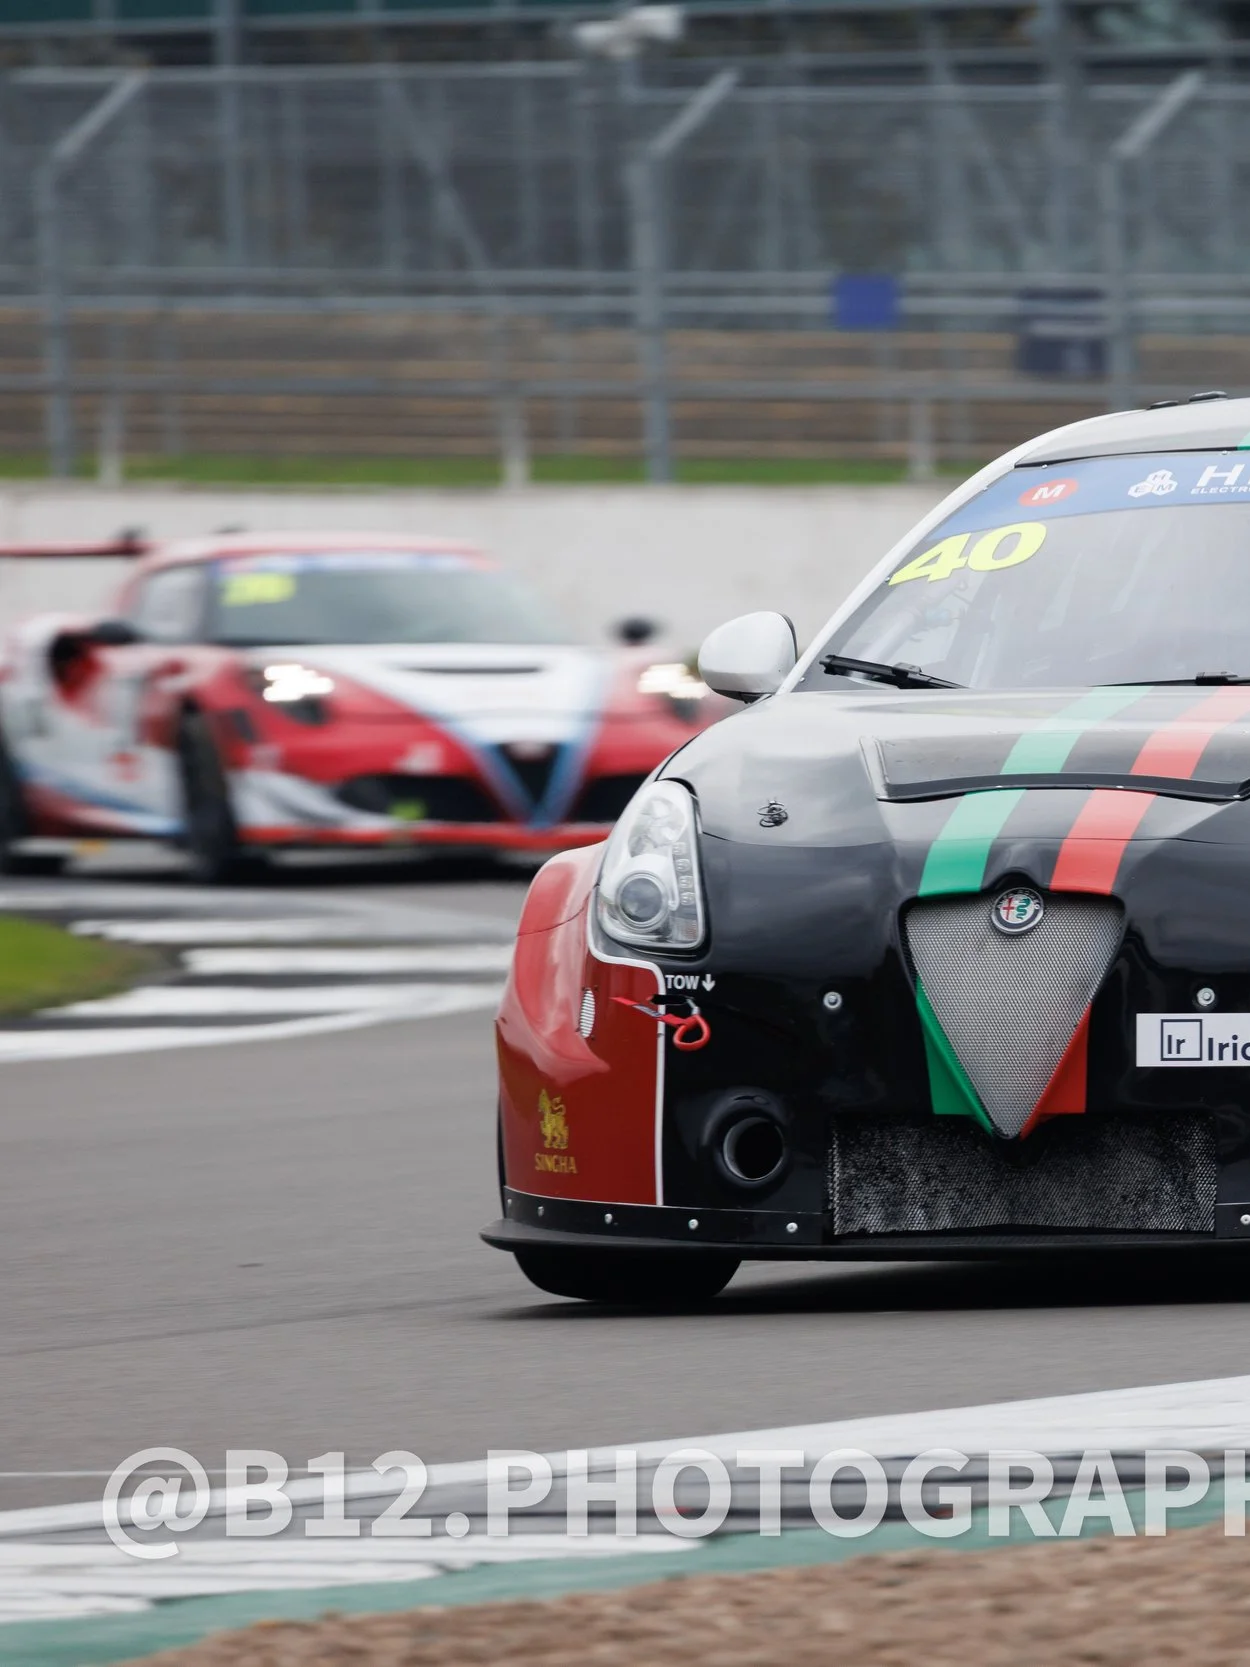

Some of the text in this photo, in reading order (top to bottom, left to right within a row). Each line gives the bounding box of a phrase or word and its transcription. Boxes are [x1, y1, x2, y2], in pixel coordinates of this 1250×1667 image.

[1032, 483, 1066, 501] M
[888, 521, 1047, 585] 40
[665, 975, 700, 990] TOW
[535, 1153, 578, 1174] SINGHA
